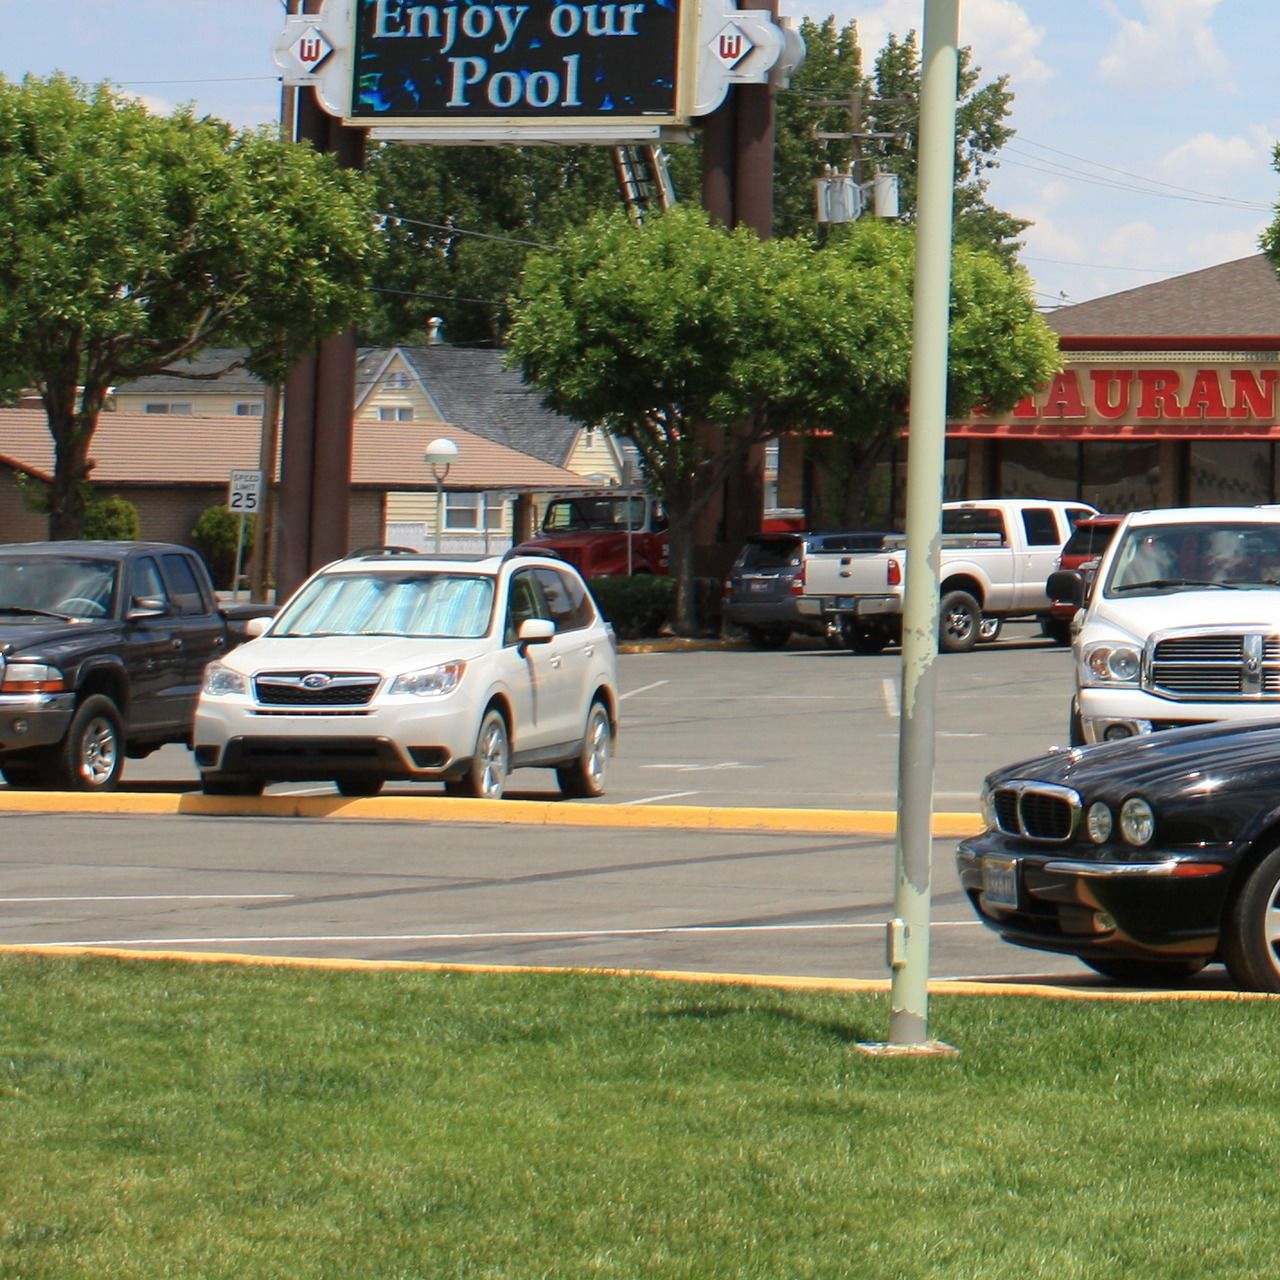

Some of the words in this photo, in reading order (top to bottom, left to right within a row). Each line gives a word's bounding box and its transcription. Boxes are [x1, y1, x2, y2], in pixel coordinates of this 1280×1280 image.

[549, 2, 646, 37] our
[445, 53, 583, 108] Pool
[231, 492, 257, 509] 25
